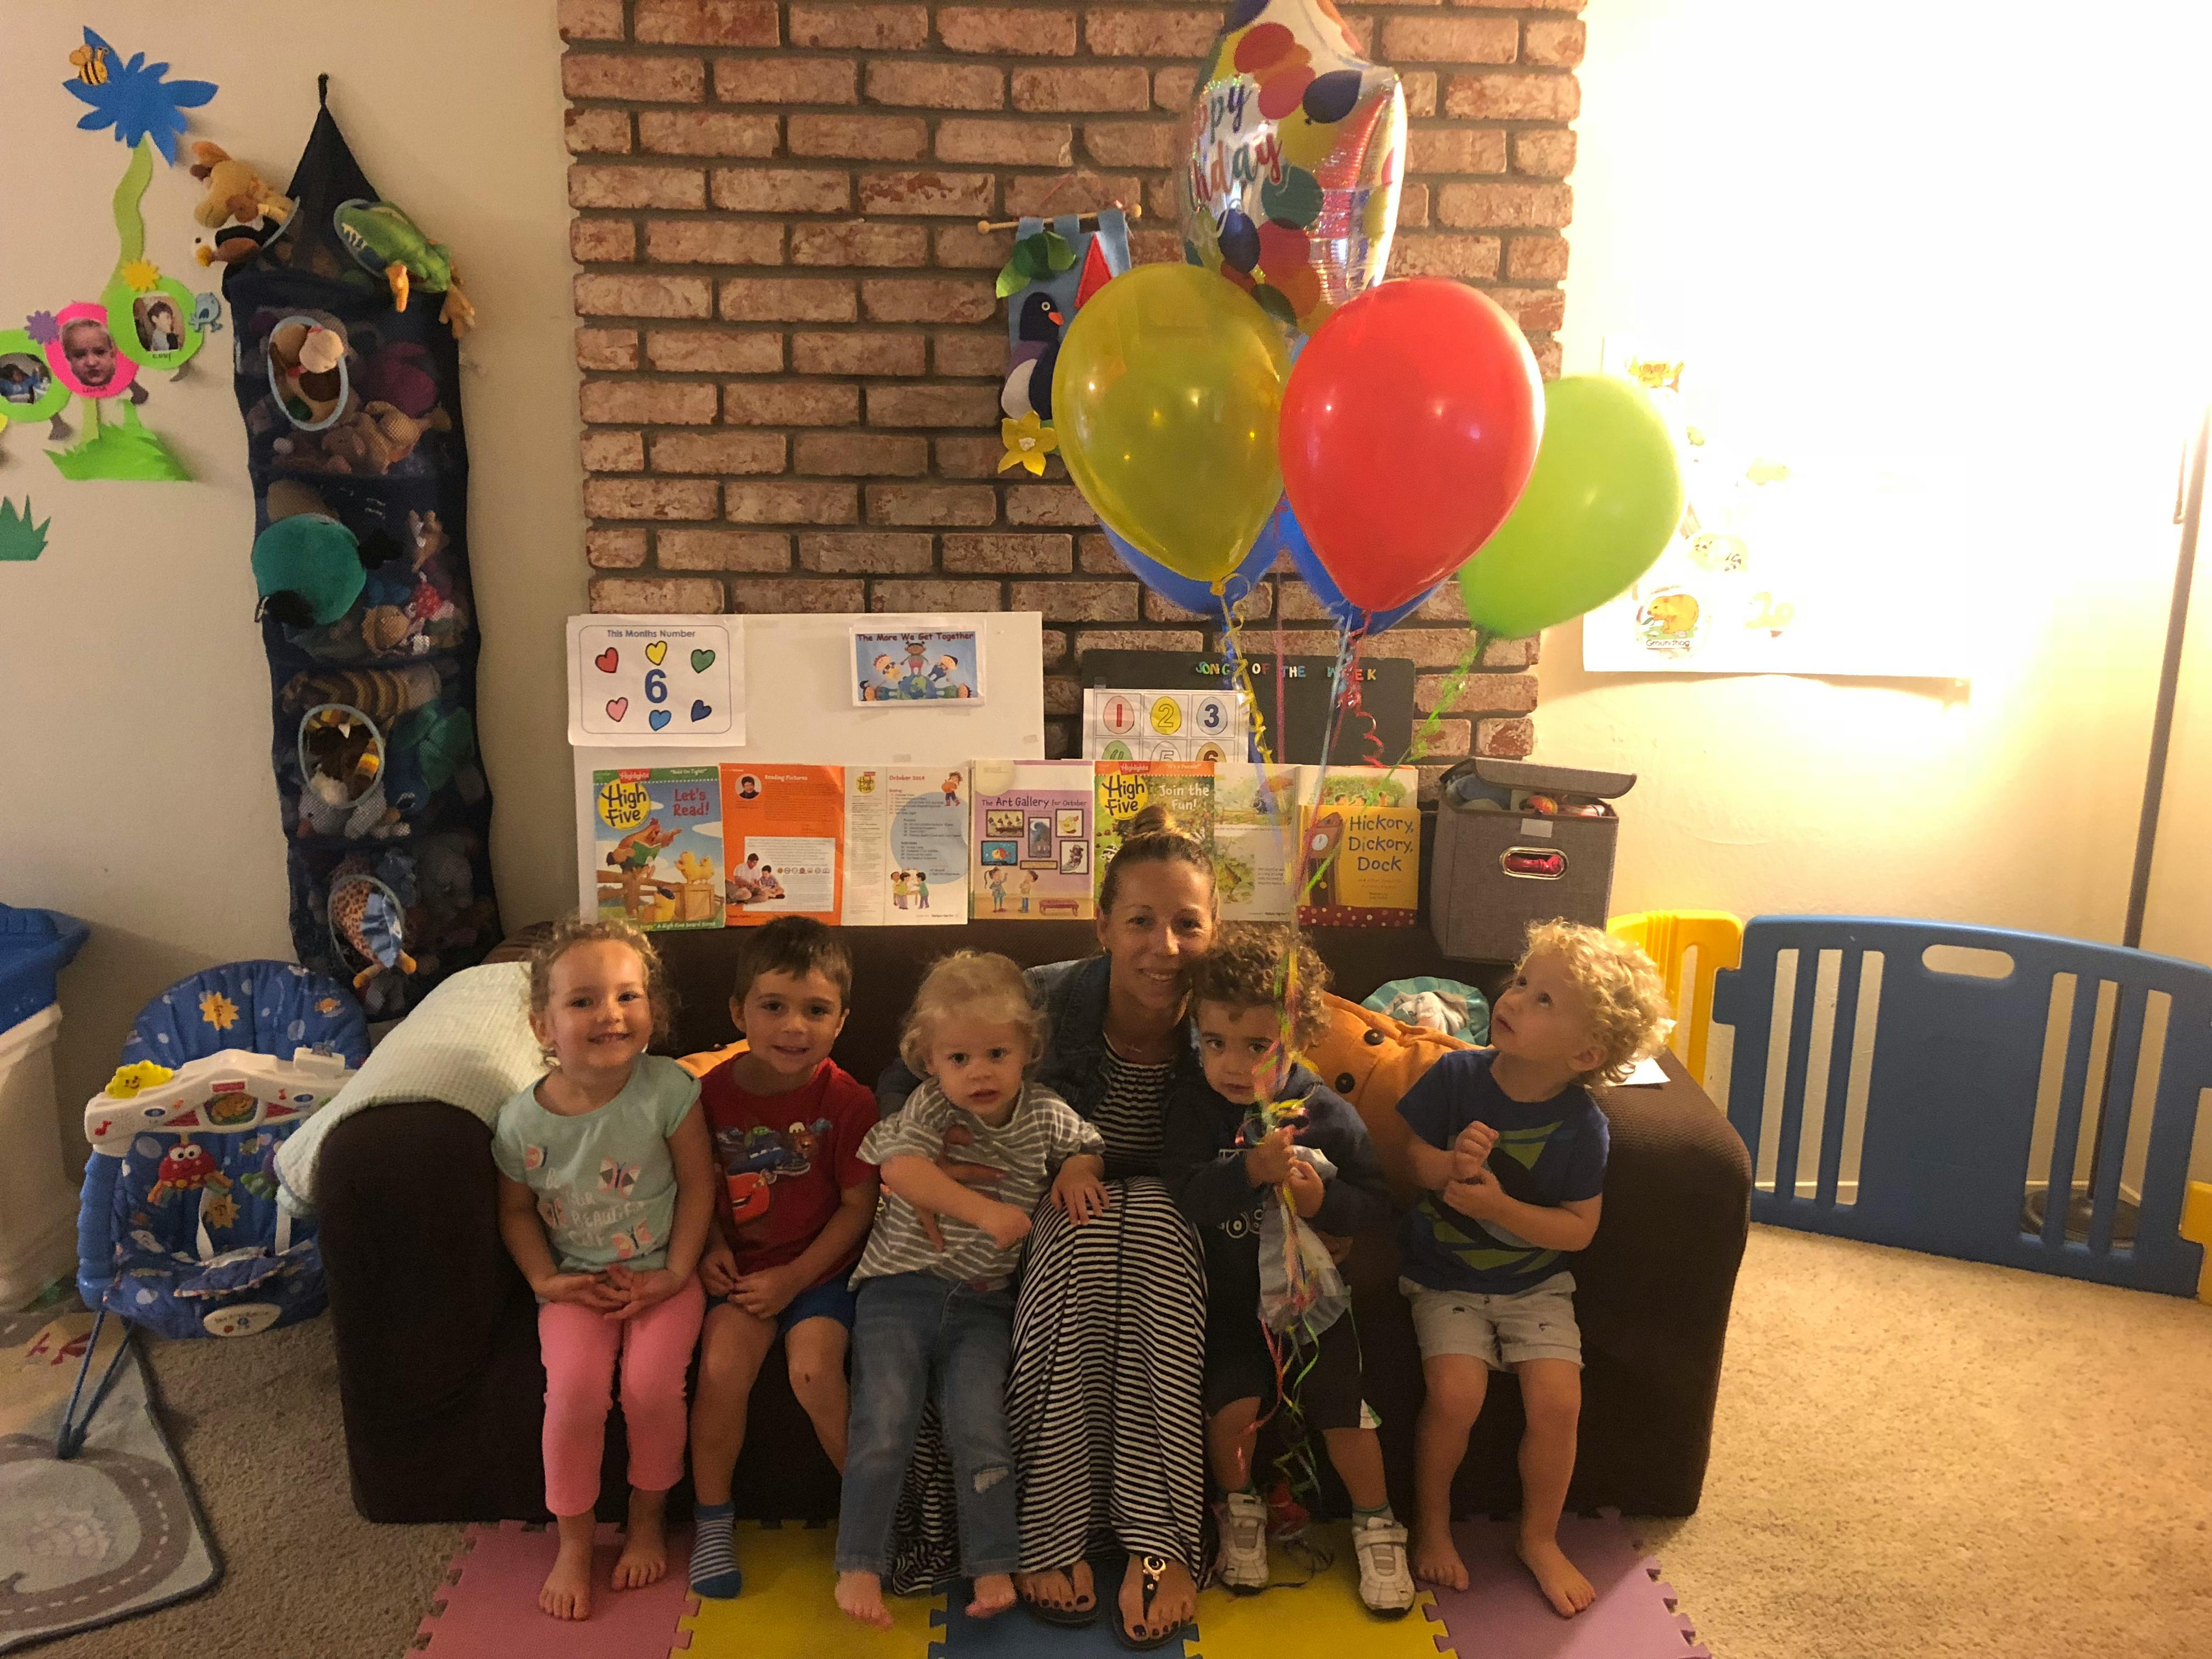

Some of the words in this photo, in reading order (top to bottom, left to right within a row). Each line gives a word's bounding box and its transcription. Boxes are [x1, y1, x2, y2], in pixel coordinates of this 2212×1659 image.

[901, 633, 915, 641] We
[918, 632, 933, 640] Get
[936, 631, 974, 642] Together
[1251, 663, 1270, 675] OF
[1327, 666, 1376, 681] WEK
[644, 668, 668, 704] 6
[1116, 703, 1122, 727] 1
[1158, 703, 1174, 727] 2
[1204, 704, 1220, 728] 3
[1120, 762, 1149, 772] Highlights
[601, 782, 647, 809] High
[674, 787, 706, 802] Let's
[1102, 774, 1145, 800] High
[1159, 785, 1184, 797] Join
[1188, 783, 1210, 797] the
[673, 802, 710, 816] Read!
[996, 797, 1013, 807] Art
[1015, 795, 1049, 809] Gallery
[1104, 799, 1138, 816] Five
[1171, 798, 1198, 811] Fun!
[605, 809, 641, 827] Five
[1350, 814, 1414, 833] Hickory,
[1348, 836, 1413, 854] Dickory,
[1358, 856, 1402, 872] Dock
